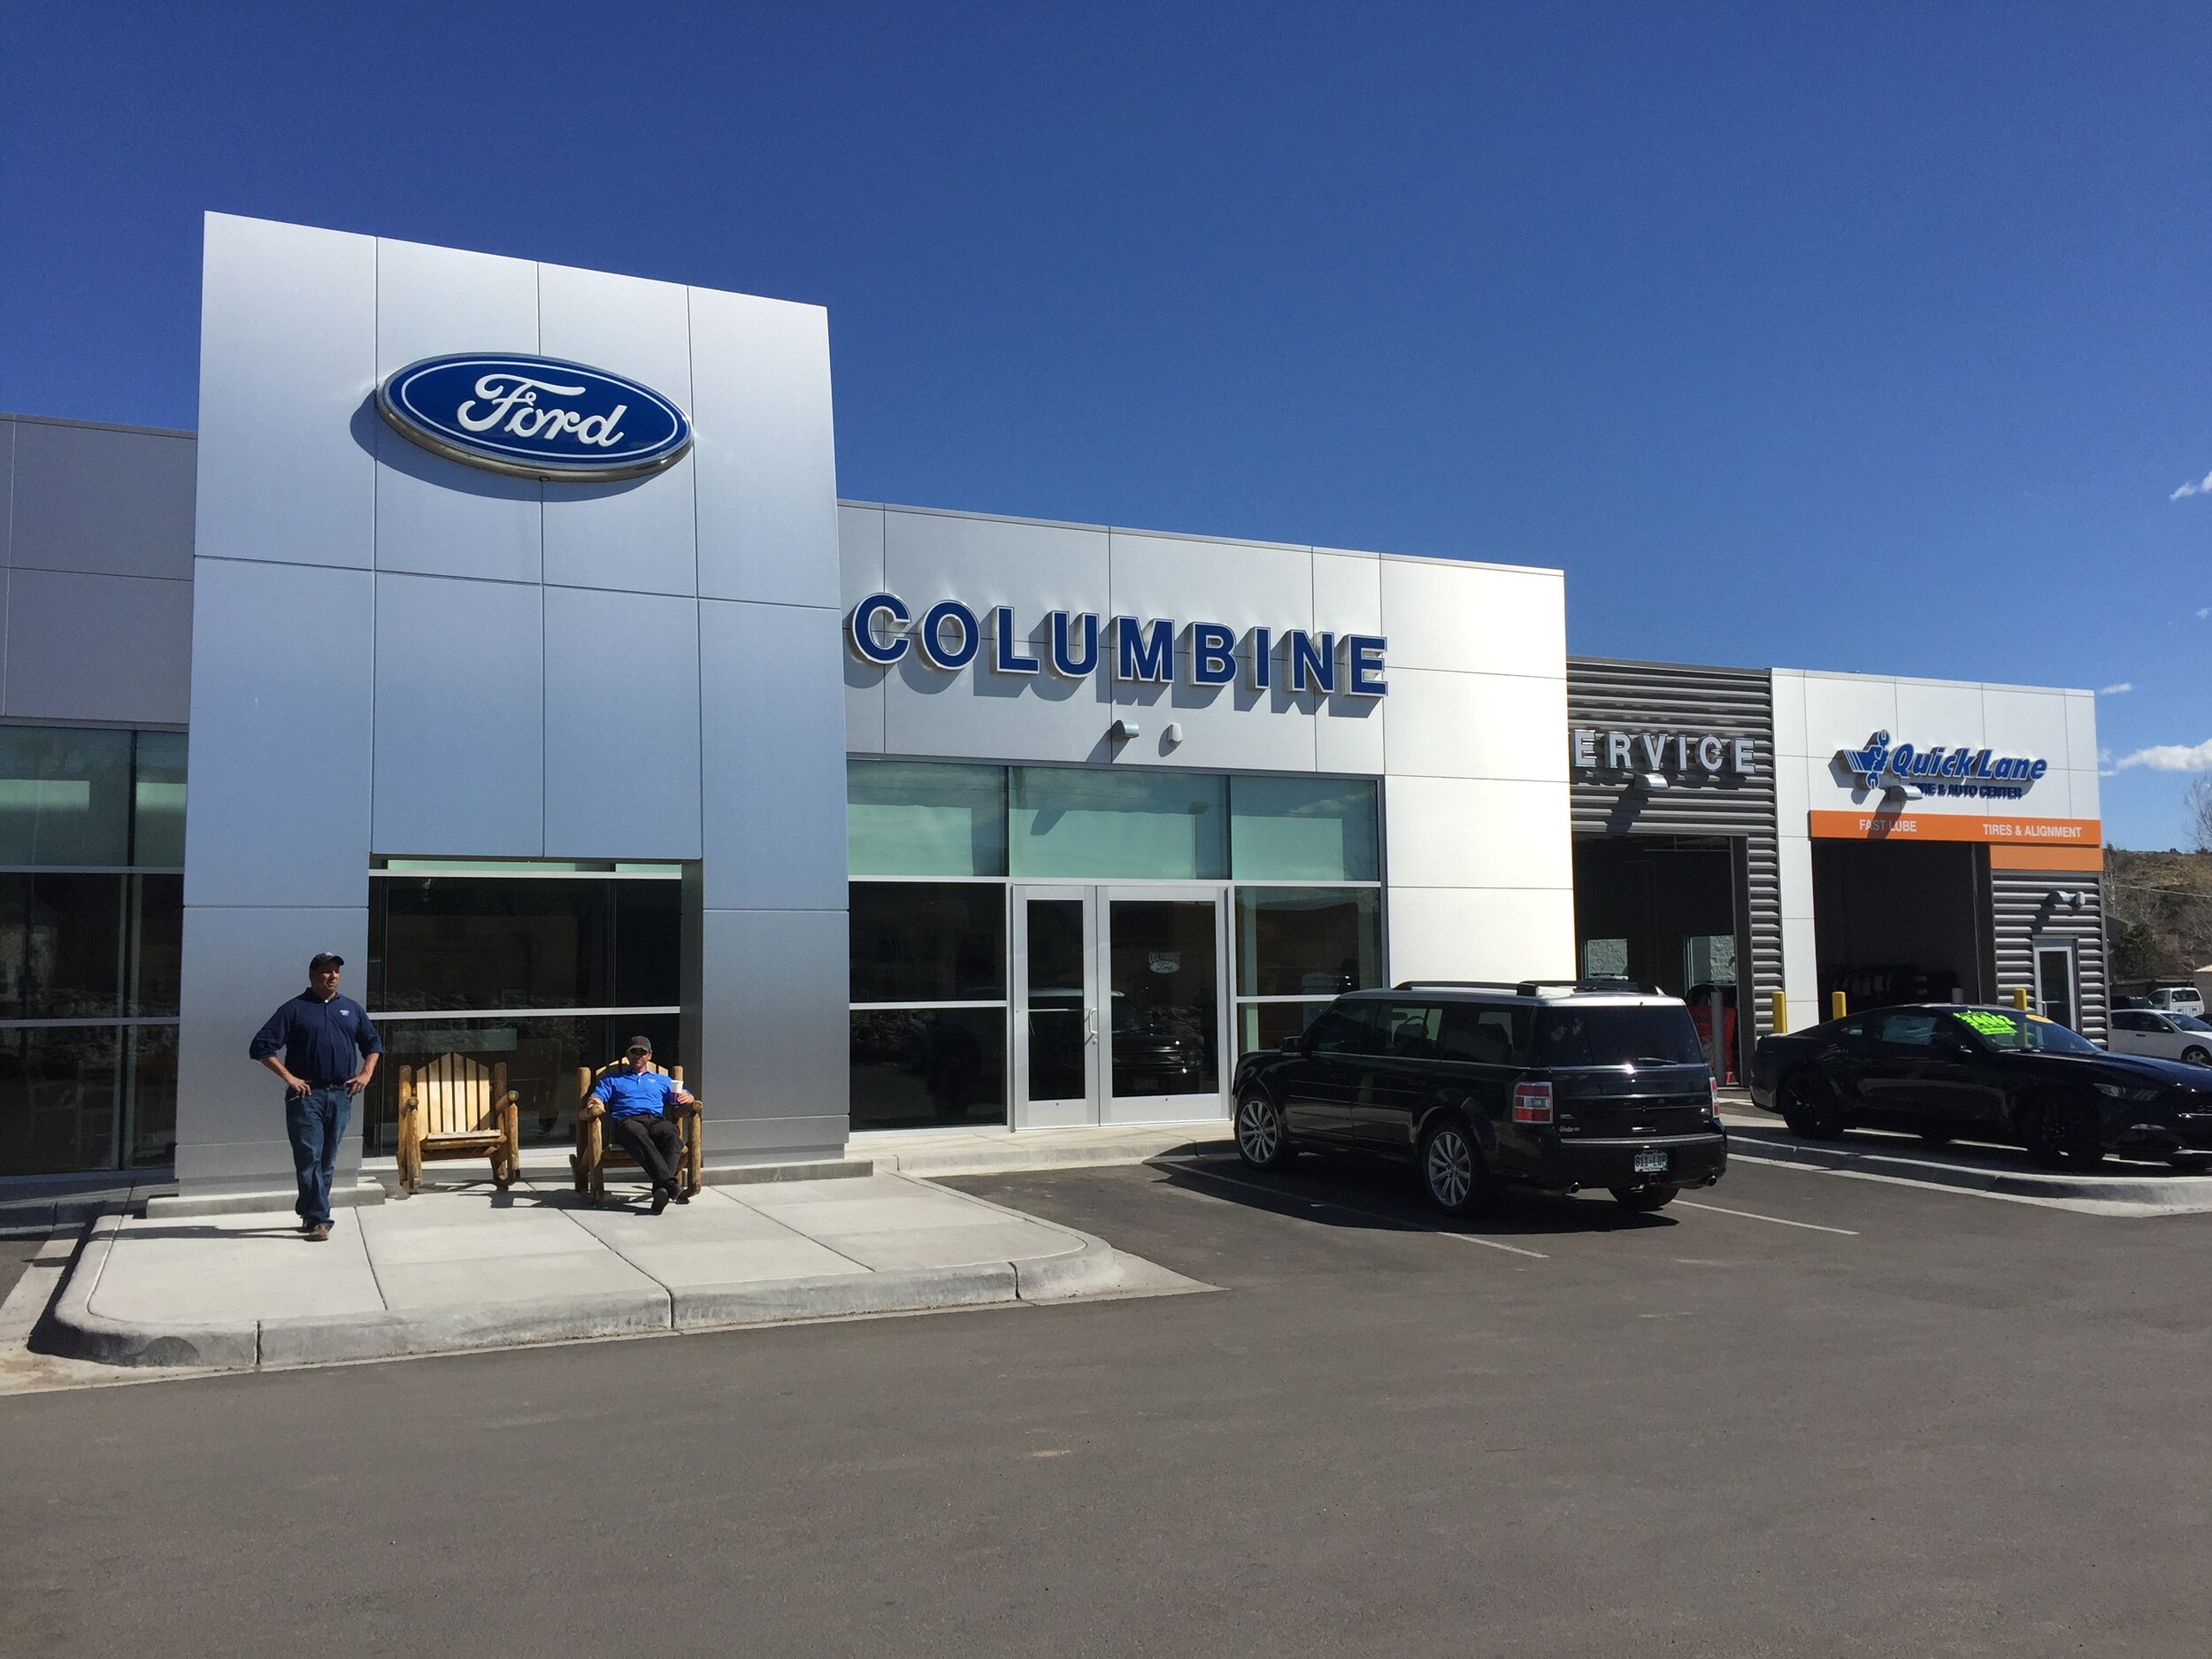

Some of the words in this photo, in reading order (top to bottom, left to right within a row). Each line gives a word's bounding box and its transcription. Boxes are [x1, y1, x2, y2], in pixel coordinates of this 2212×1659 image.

[458, 373, 627, 447] Ford
[852, 593, 1388, 697] COLUMBINE
[1571, 729, 1755, 774] ERVICE
[1938, 785, 1947, 796] &
[1947, 785, 1978, 798] AUTO
[1979, 787, 2023, 800] CENTER
[1859, 819, 1886, 831] FAST
[1890, 820, 1917, 832] LUBE
[1983, 824, 2013, 836] TIRES
[2015, 826, 2023, 836] &
[2024, 826, 2082, 838] ALIGNMENT
